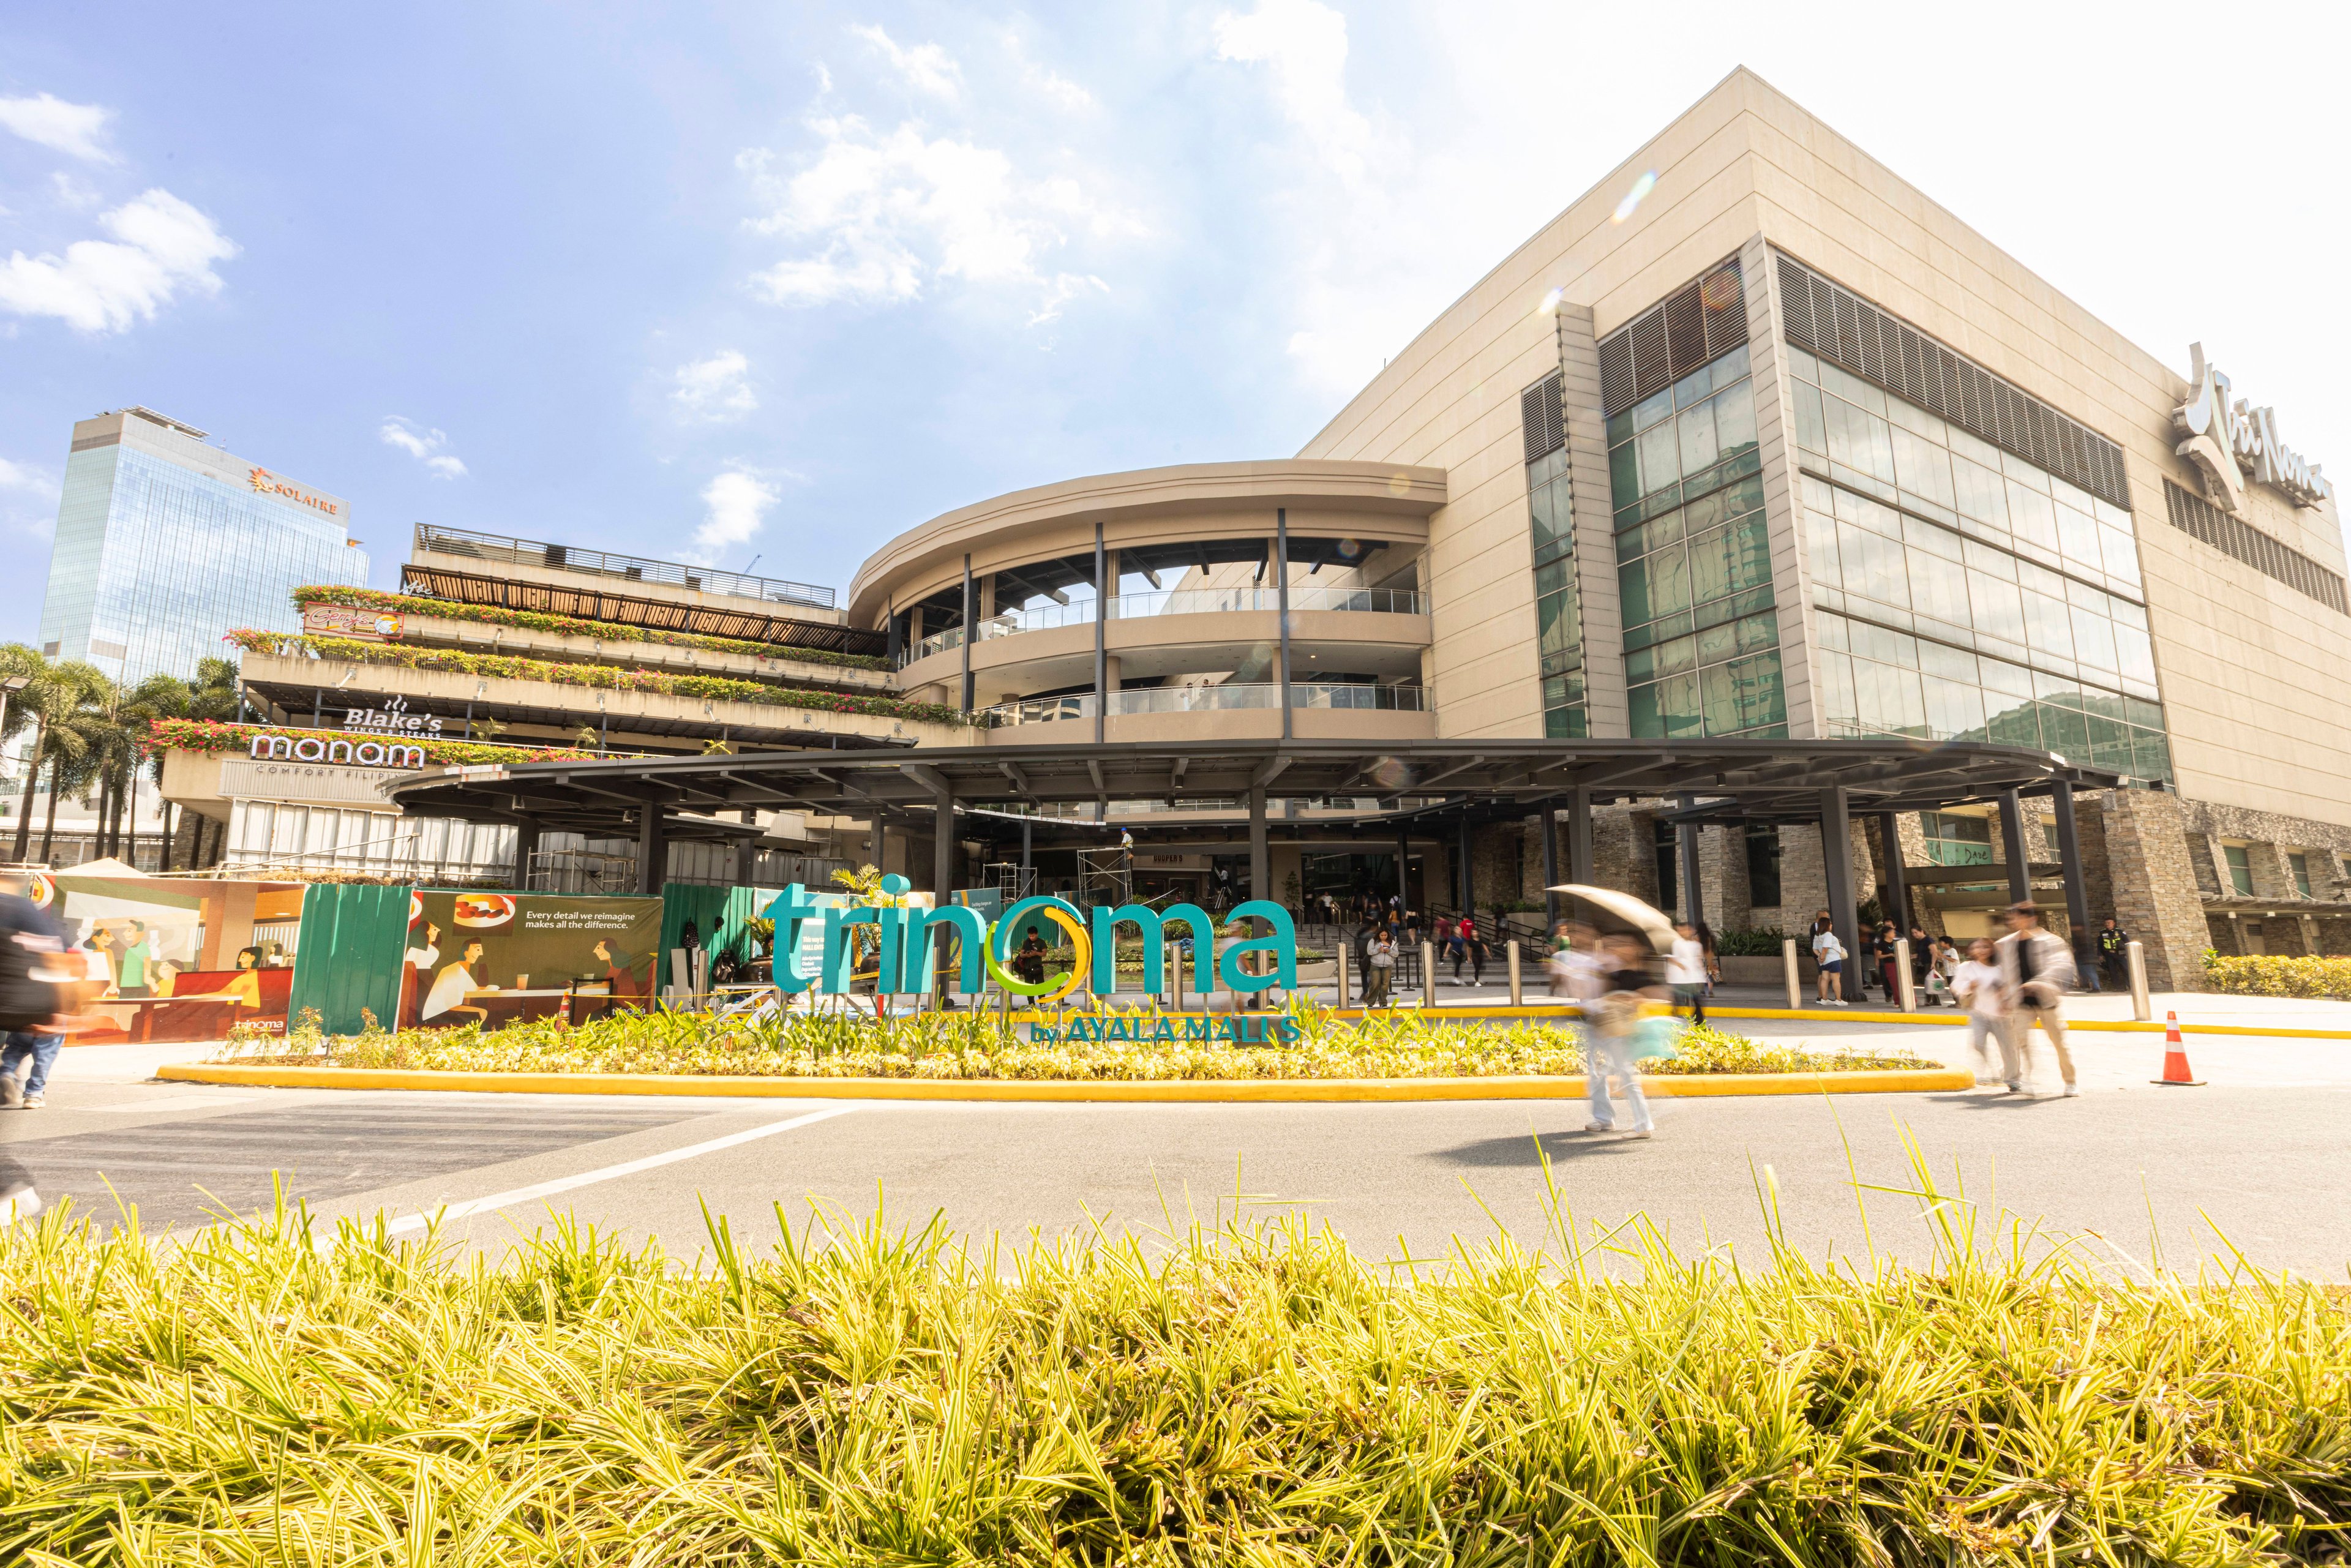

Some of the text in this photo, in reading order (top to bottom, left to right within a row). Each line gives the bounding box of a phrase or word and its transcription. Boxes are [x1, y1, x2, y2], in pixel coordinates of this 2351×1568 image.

[276, 482, 337, 514] SOLAIRE
[399, 580, 433, 595] Abe
[309, 607, 369, 628] Gerry's
[343, 708, 443, 732] Blake's
[399, 730, 441, 738] STEAKS
[251, 735, 424, 768] manam
[257, 766, 334, 776] COMFORT
[1964, 847, 1989, 864] Dare
[527, 911, 552, 920] Every
[594, 913, 635, 921] reimagine
[762, 873, 1297, 1003] trinoma
[1030, 1016, 1302, 1049] by AYALA MALLS
